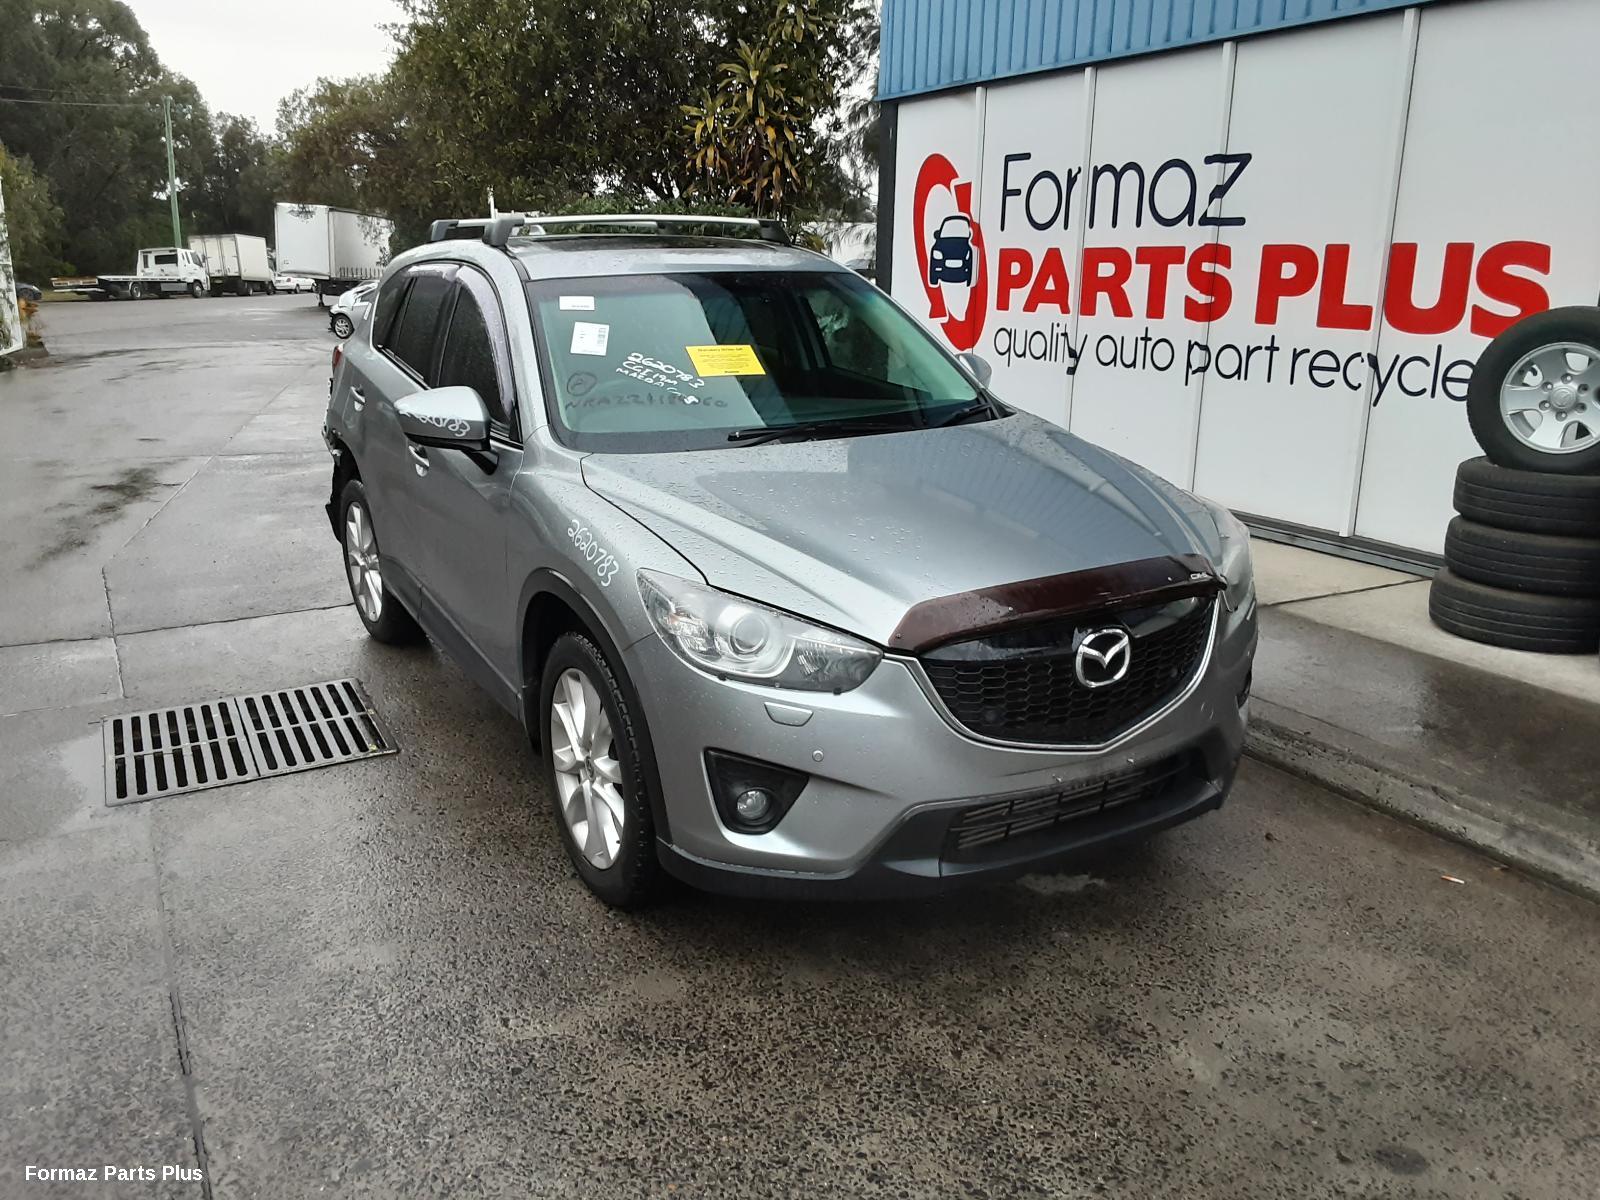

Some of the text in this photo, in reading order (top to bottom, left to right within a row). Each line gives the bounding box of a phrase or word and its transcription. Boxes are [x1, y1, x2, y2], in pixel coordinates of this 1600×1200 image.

[1000, 152, 1253, 236] Formaz
[995, 241, 1552, 339] PARTS PLUS
[993, 322, 1088, 378] quality
[1095, 326, 1175, 372] auto
[1184, 334, 1280, 387] part
[567, 519, 620, 587] 2620783
